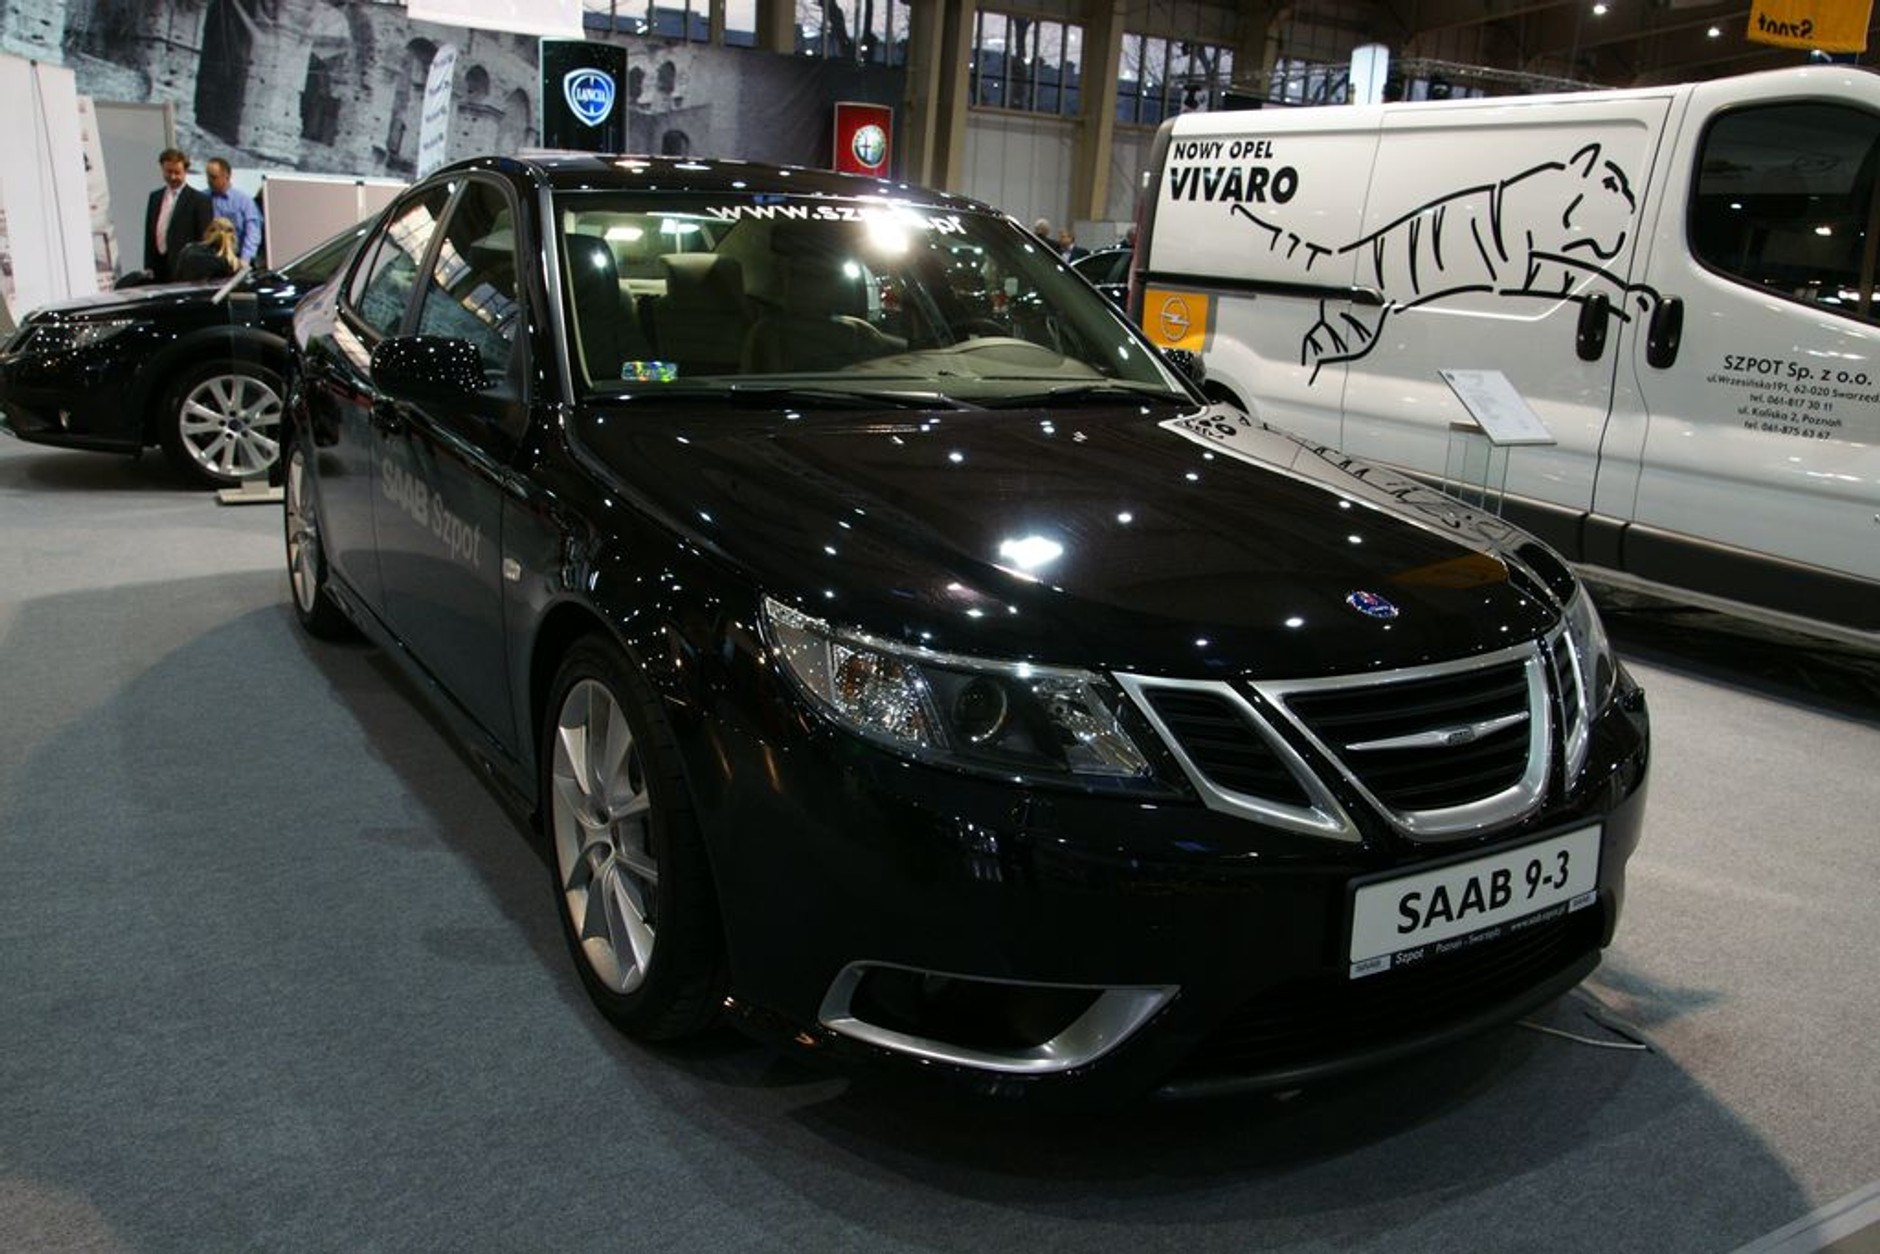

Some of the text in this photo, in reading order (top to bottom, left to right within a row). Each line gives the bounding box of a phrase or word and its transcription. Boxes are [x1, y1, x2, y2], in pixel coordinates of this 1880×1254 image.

[1173, 140, 1274, 160] NOWY OPEL
[1170, 166, 1299, 204] VIVARO
[706, 205, 967, 235] www.sz.pl
[1723, 354, 1873, 386] SZPOT Sp. z o.o.
[1793, 385, 1830, 397] 62-020
[382, 458, 481, 569] SAAB Szpot
[1397, 850, 1570, 934] SAAB 9-3
